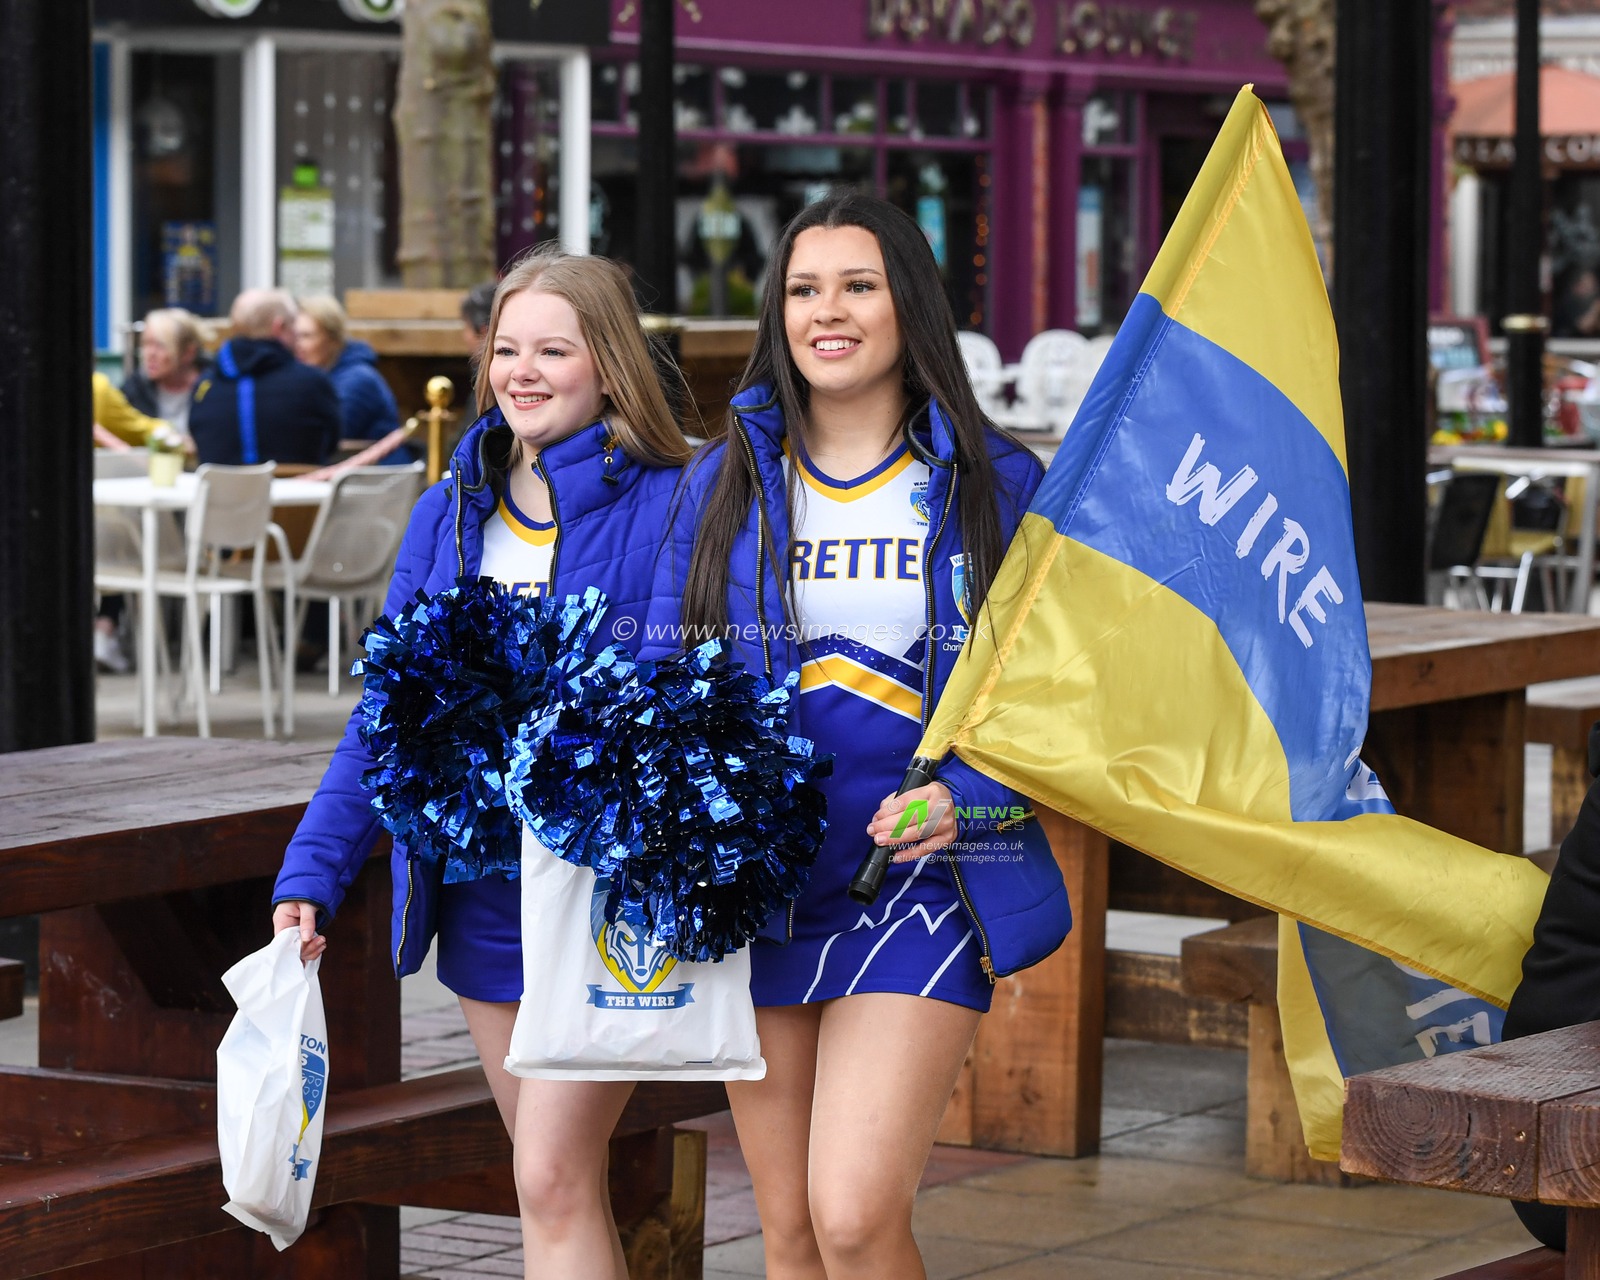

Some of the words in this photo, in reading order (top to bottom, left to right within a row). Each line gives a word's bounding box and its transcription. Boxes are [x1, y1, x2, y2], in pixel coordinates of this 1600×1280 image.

[1166, 433, 1344, 648] WIRE
[605, 995, 635, 1007] THE
[638, 995, 675, 1007] WIRE
